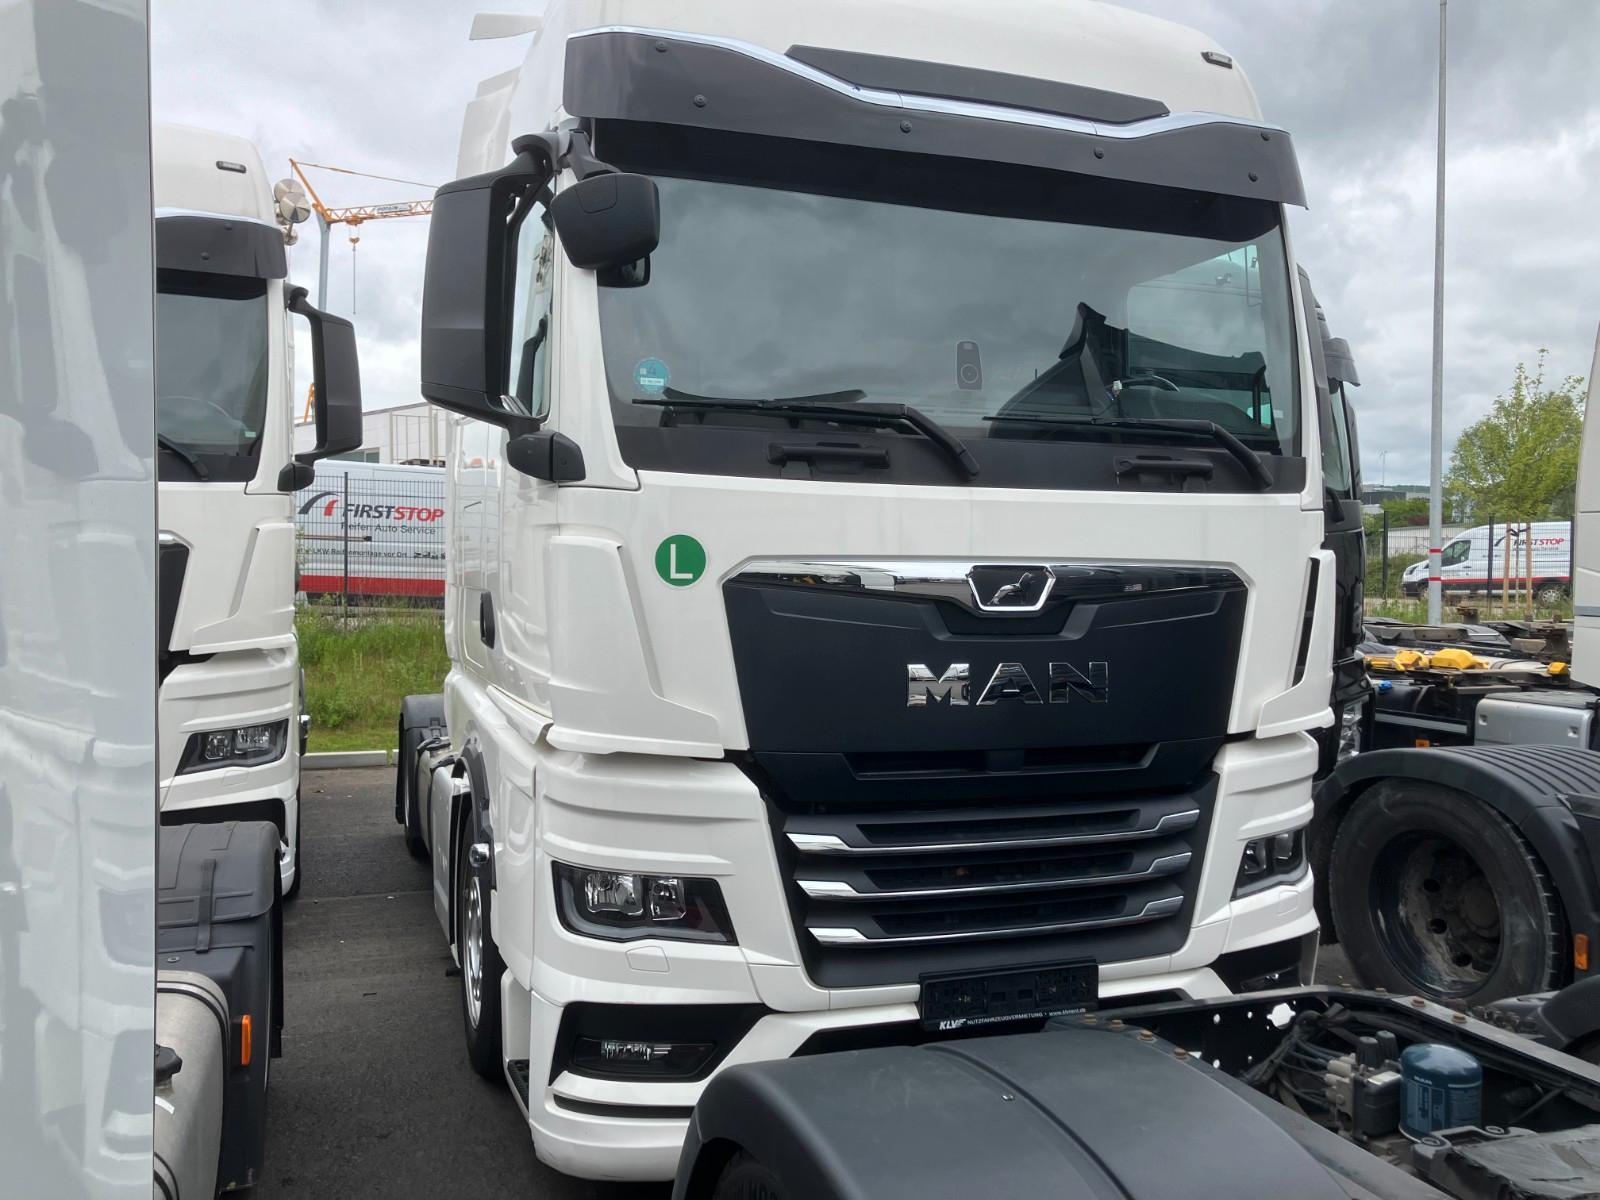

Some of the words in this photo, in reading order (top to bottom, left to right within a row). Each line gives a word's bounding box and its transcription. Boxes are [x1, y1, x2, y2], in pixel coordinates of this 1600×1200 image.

[343, 503, 445, 522] FIRSTSTOP
[374, 523, 398, 533] Auto
[400, 525, 436, 535] Service
[670, 543, 693, 579] L
[907, 662, 1108, 706] MAN
